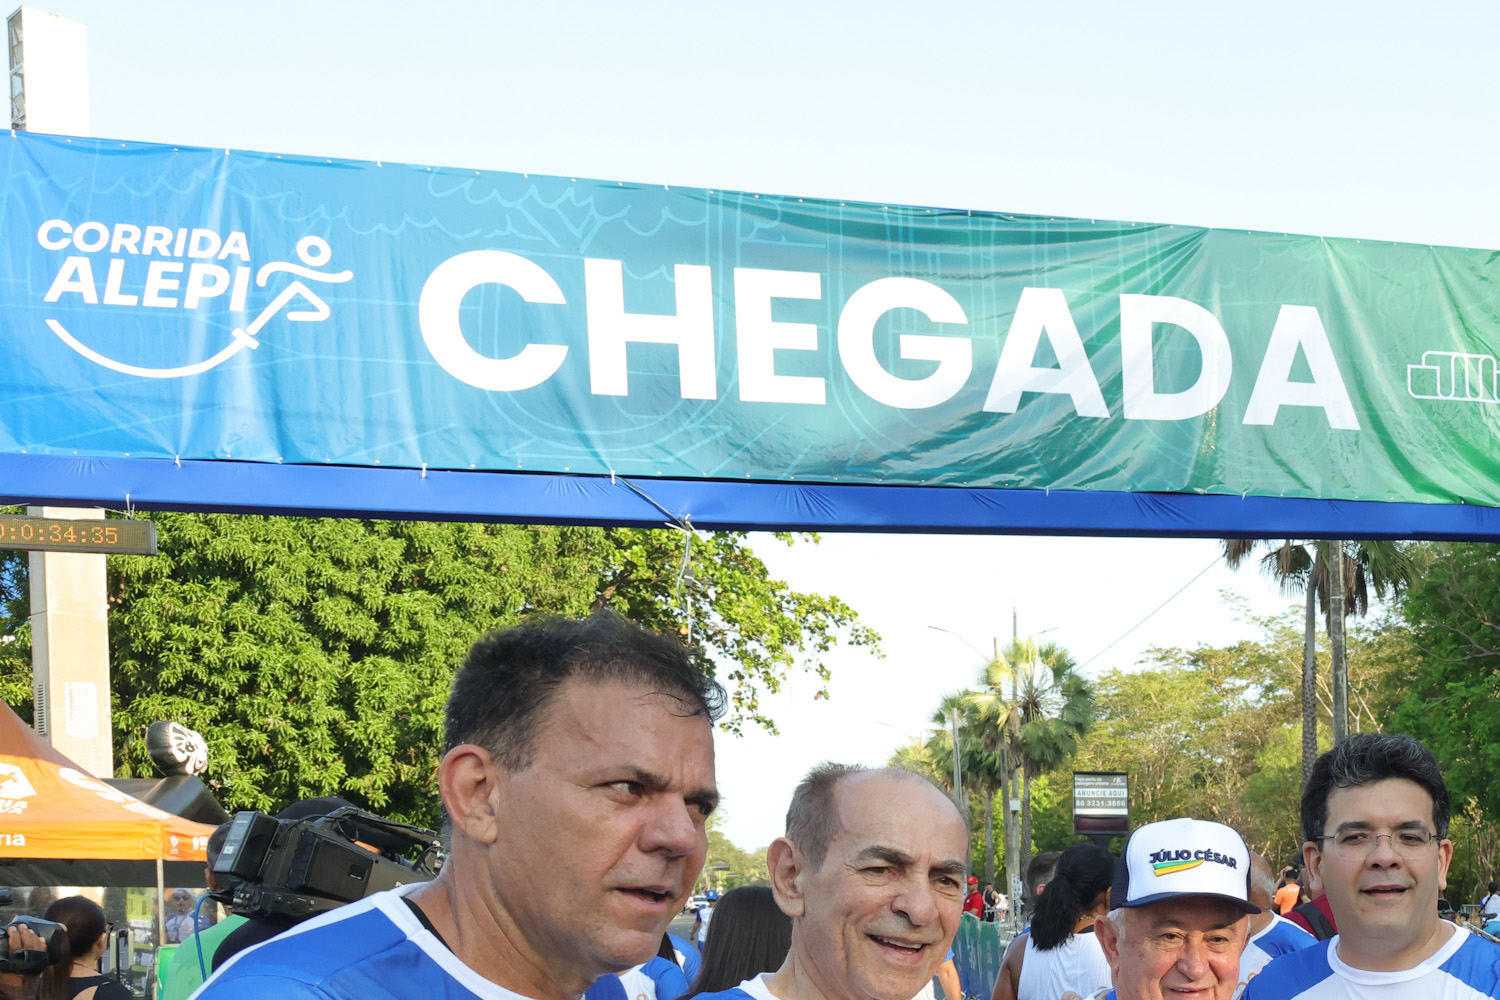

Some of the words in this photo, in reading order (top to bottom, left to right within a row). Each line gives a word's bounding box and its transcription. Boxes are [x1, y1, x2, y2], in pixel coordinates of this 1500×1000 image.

[36, 218, 251, 262] CORRIDA
[44, 257, 251, 313] ALEPI
[418, 248, 1361, 431] CHEGADA
[1149, 849, 1192, 864] JÚLIO
[1193, 848, 1237, 870] CÉSAR
